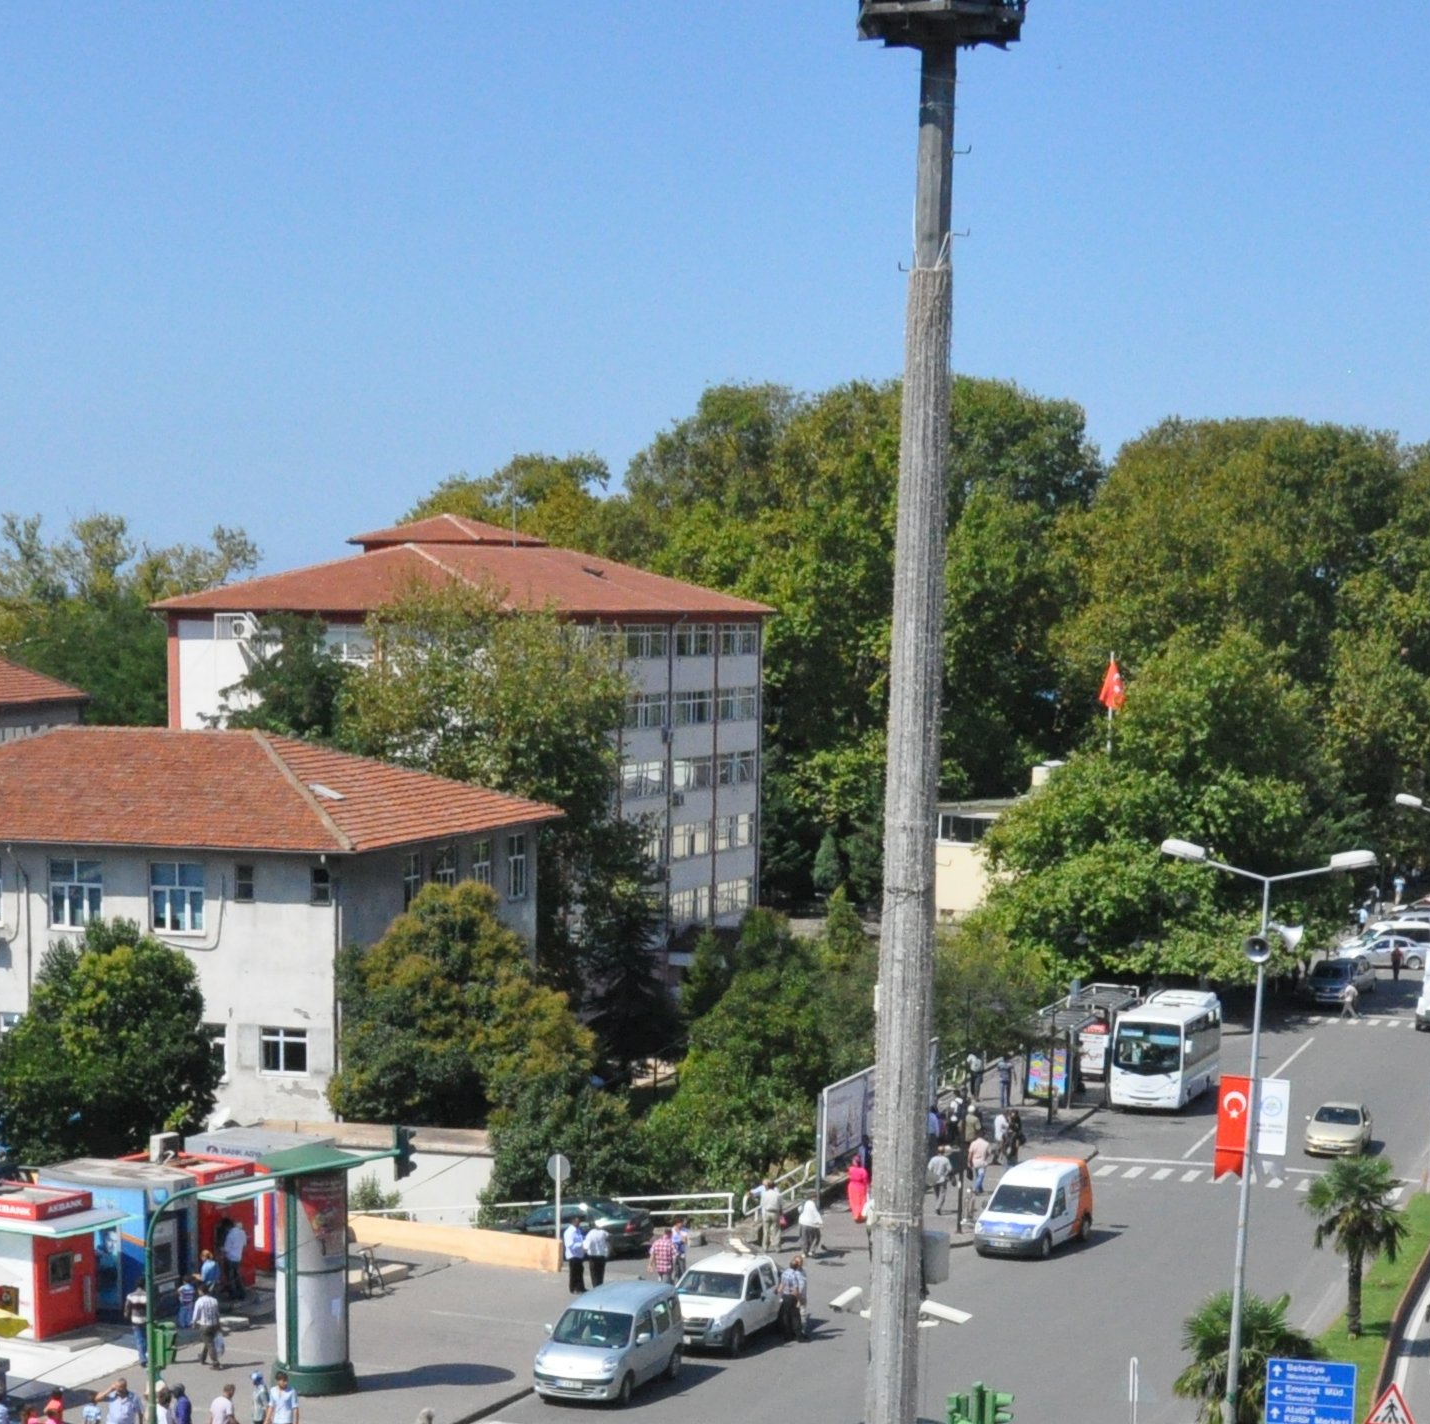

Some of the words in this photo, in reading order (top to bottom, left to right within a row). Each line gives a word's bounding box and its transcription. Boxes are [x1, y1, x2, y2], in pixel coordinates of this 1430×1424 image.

[46, 1198, 84, 1215] AKBANK
[1286, 1364, 1326, 1374] Belediye
[1285, 1385, 1320, 1395] Emniyet
[1284, 1406, 1316, 1415] Atatürk
[1284, 1414, 1310, 1424] Kültür
